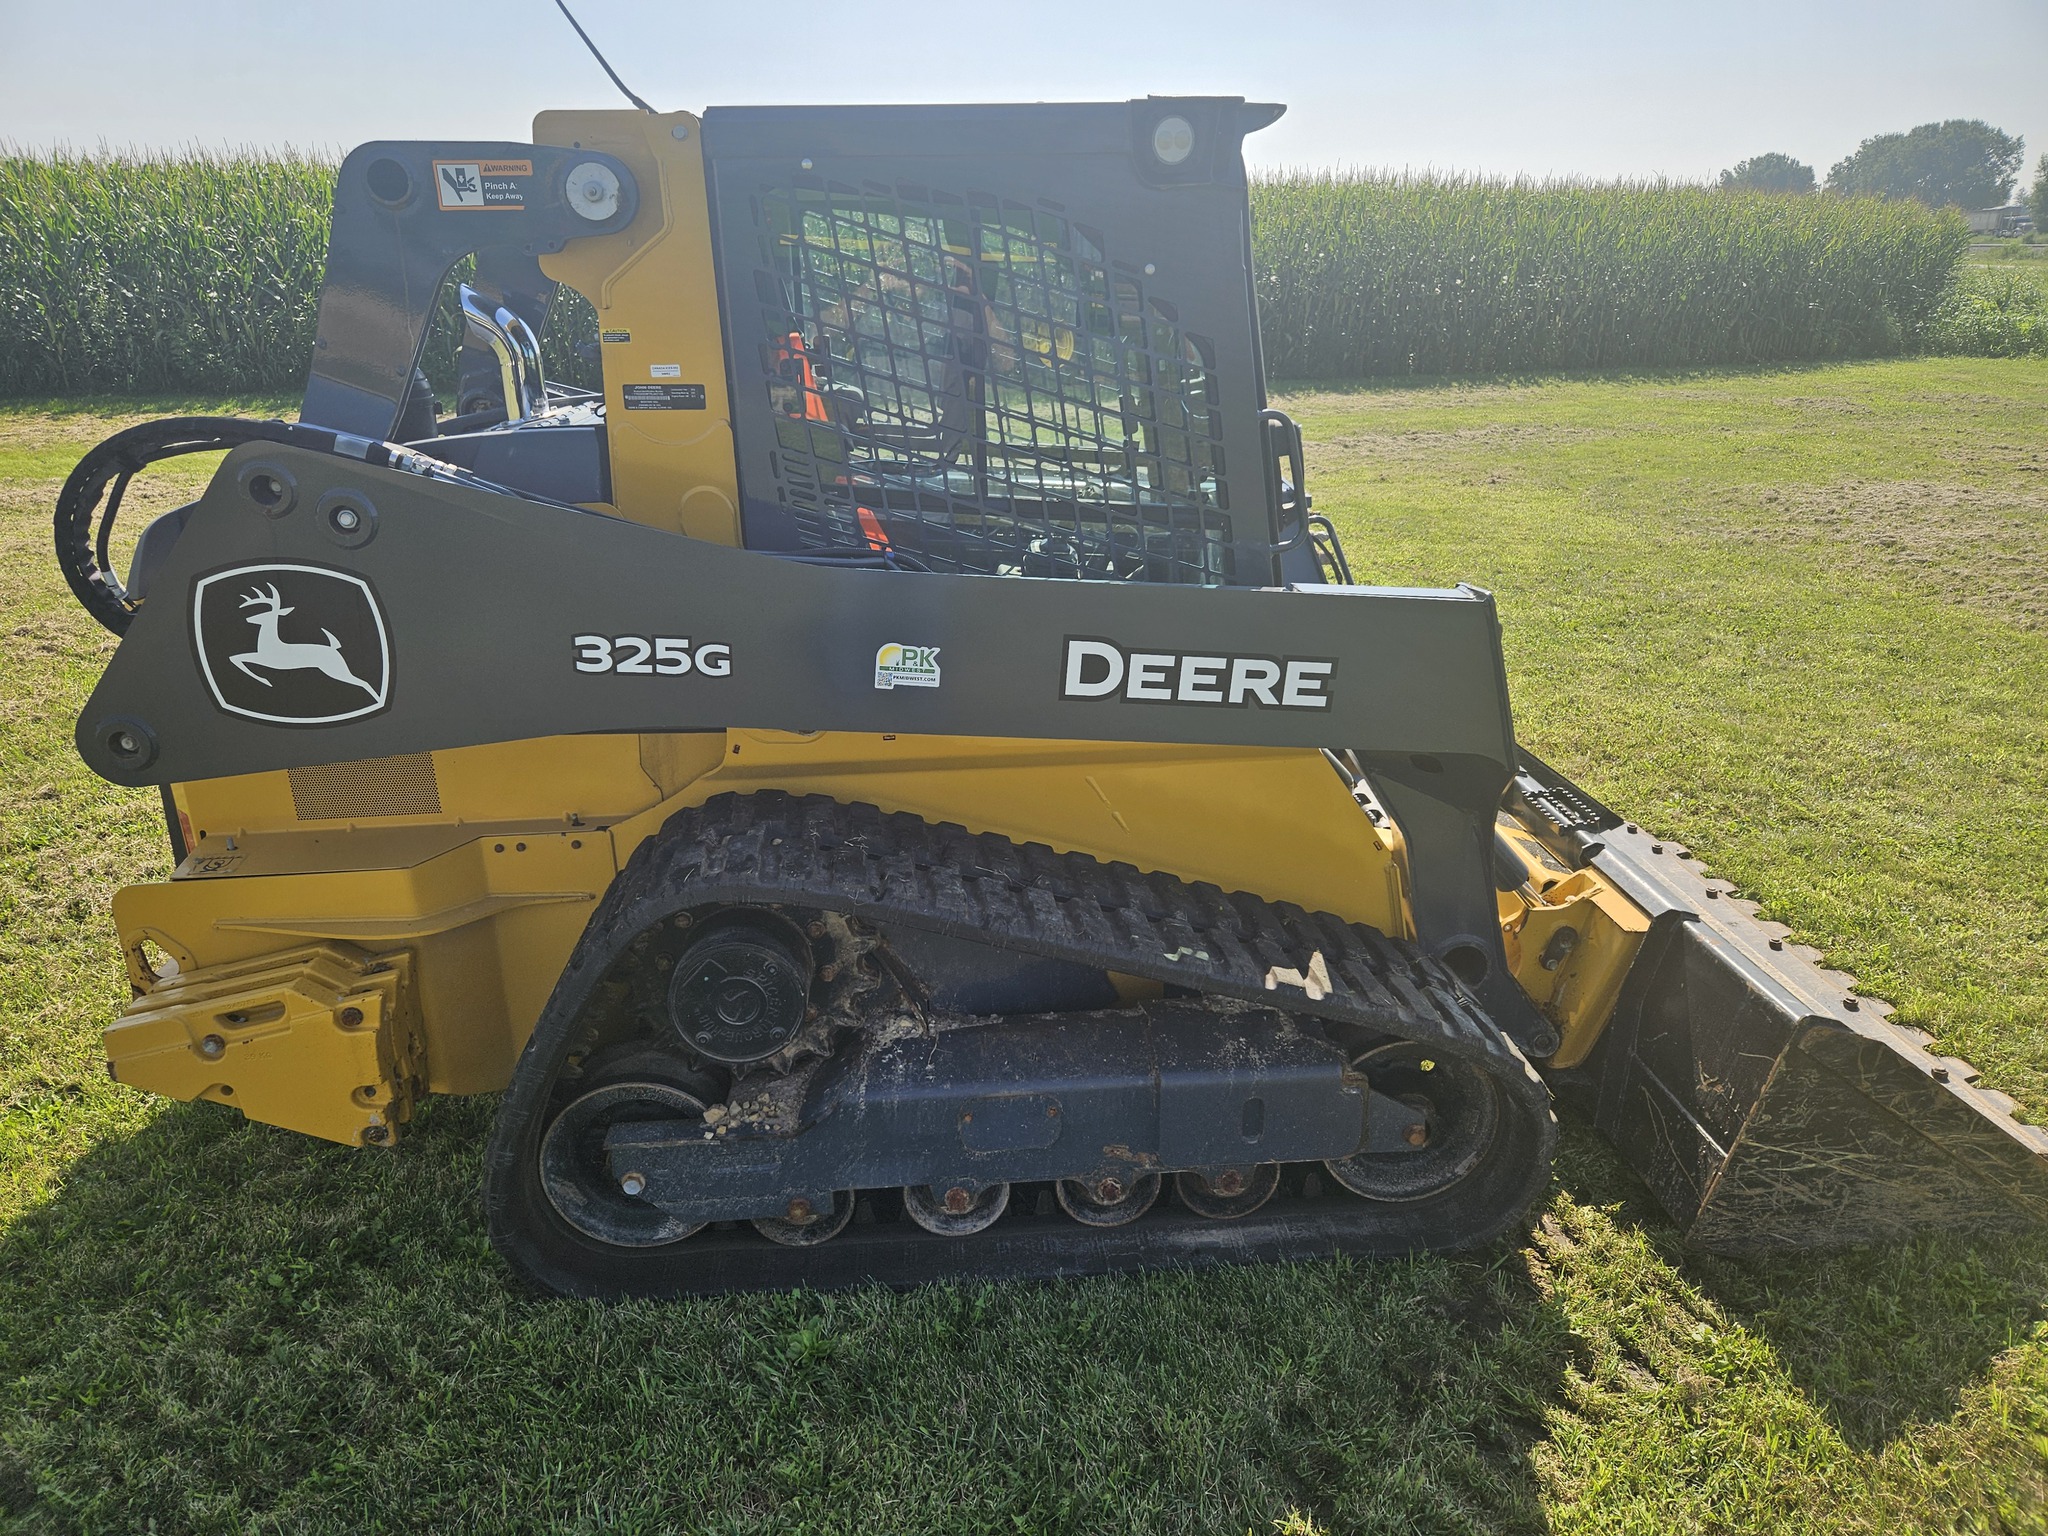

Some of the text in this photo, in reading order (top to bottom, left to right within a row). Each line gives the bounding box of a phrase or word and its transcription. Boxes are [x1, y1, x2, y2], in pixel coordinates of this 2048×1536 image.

[484, 182, 508, 190] Pinch
[486, 193, 523, 201] Keep Away
[574, 635, 731, 677] 325G
[1064, 640, 1333, 707] DEERE
